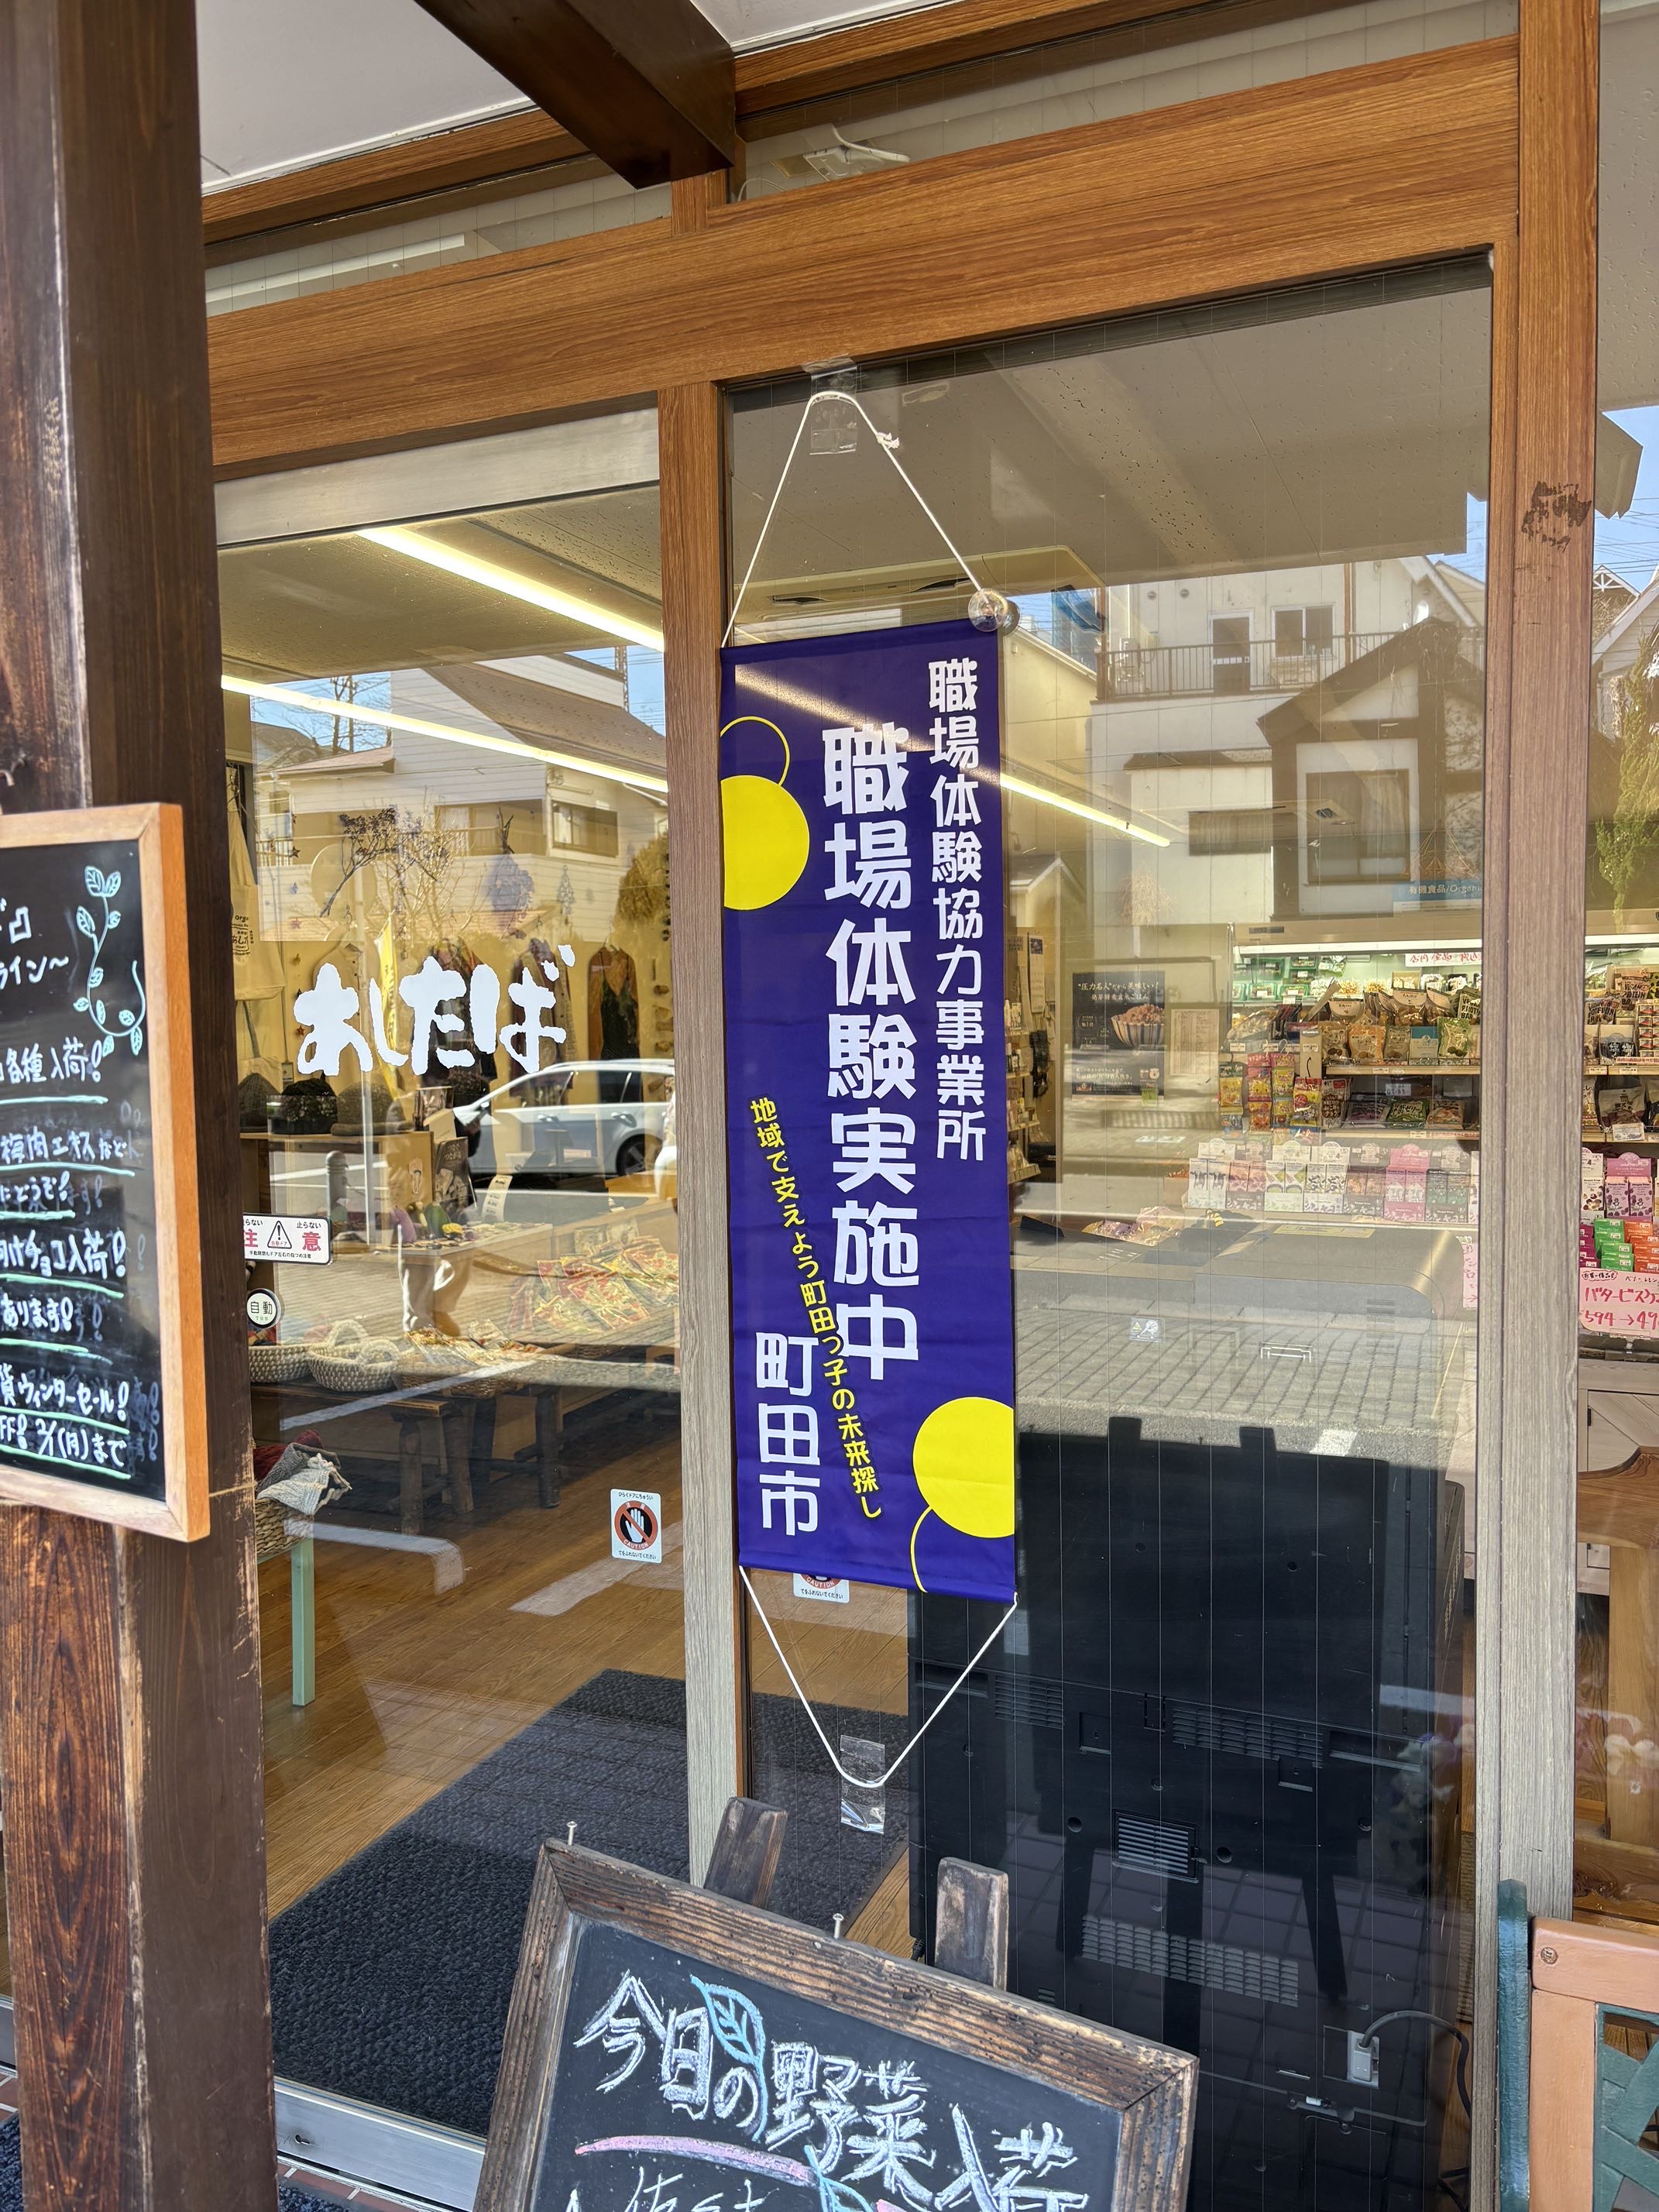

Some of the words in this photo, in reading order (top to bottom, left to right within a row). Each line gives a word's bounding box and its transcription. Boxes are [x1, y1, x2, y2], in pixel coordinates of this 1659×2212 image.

[929, 657, 986, 1162] 職場体験協力事業所
[294, 944, 576, 1077] あしたば
[822, 721, 919, 1381] 職場体験実施中
[250, 1301, 273, 1315] 自動
[302, 1231, 321, 1252] 意
[750, 1096, 881, 1519] 地域で支えよう町田っ子の未来探し
[755, 1331, 821, 1537] 町田市
[623, 1539, 648, 1549] CAUTION
[806, 1576, 834, 1589] CAUTION
